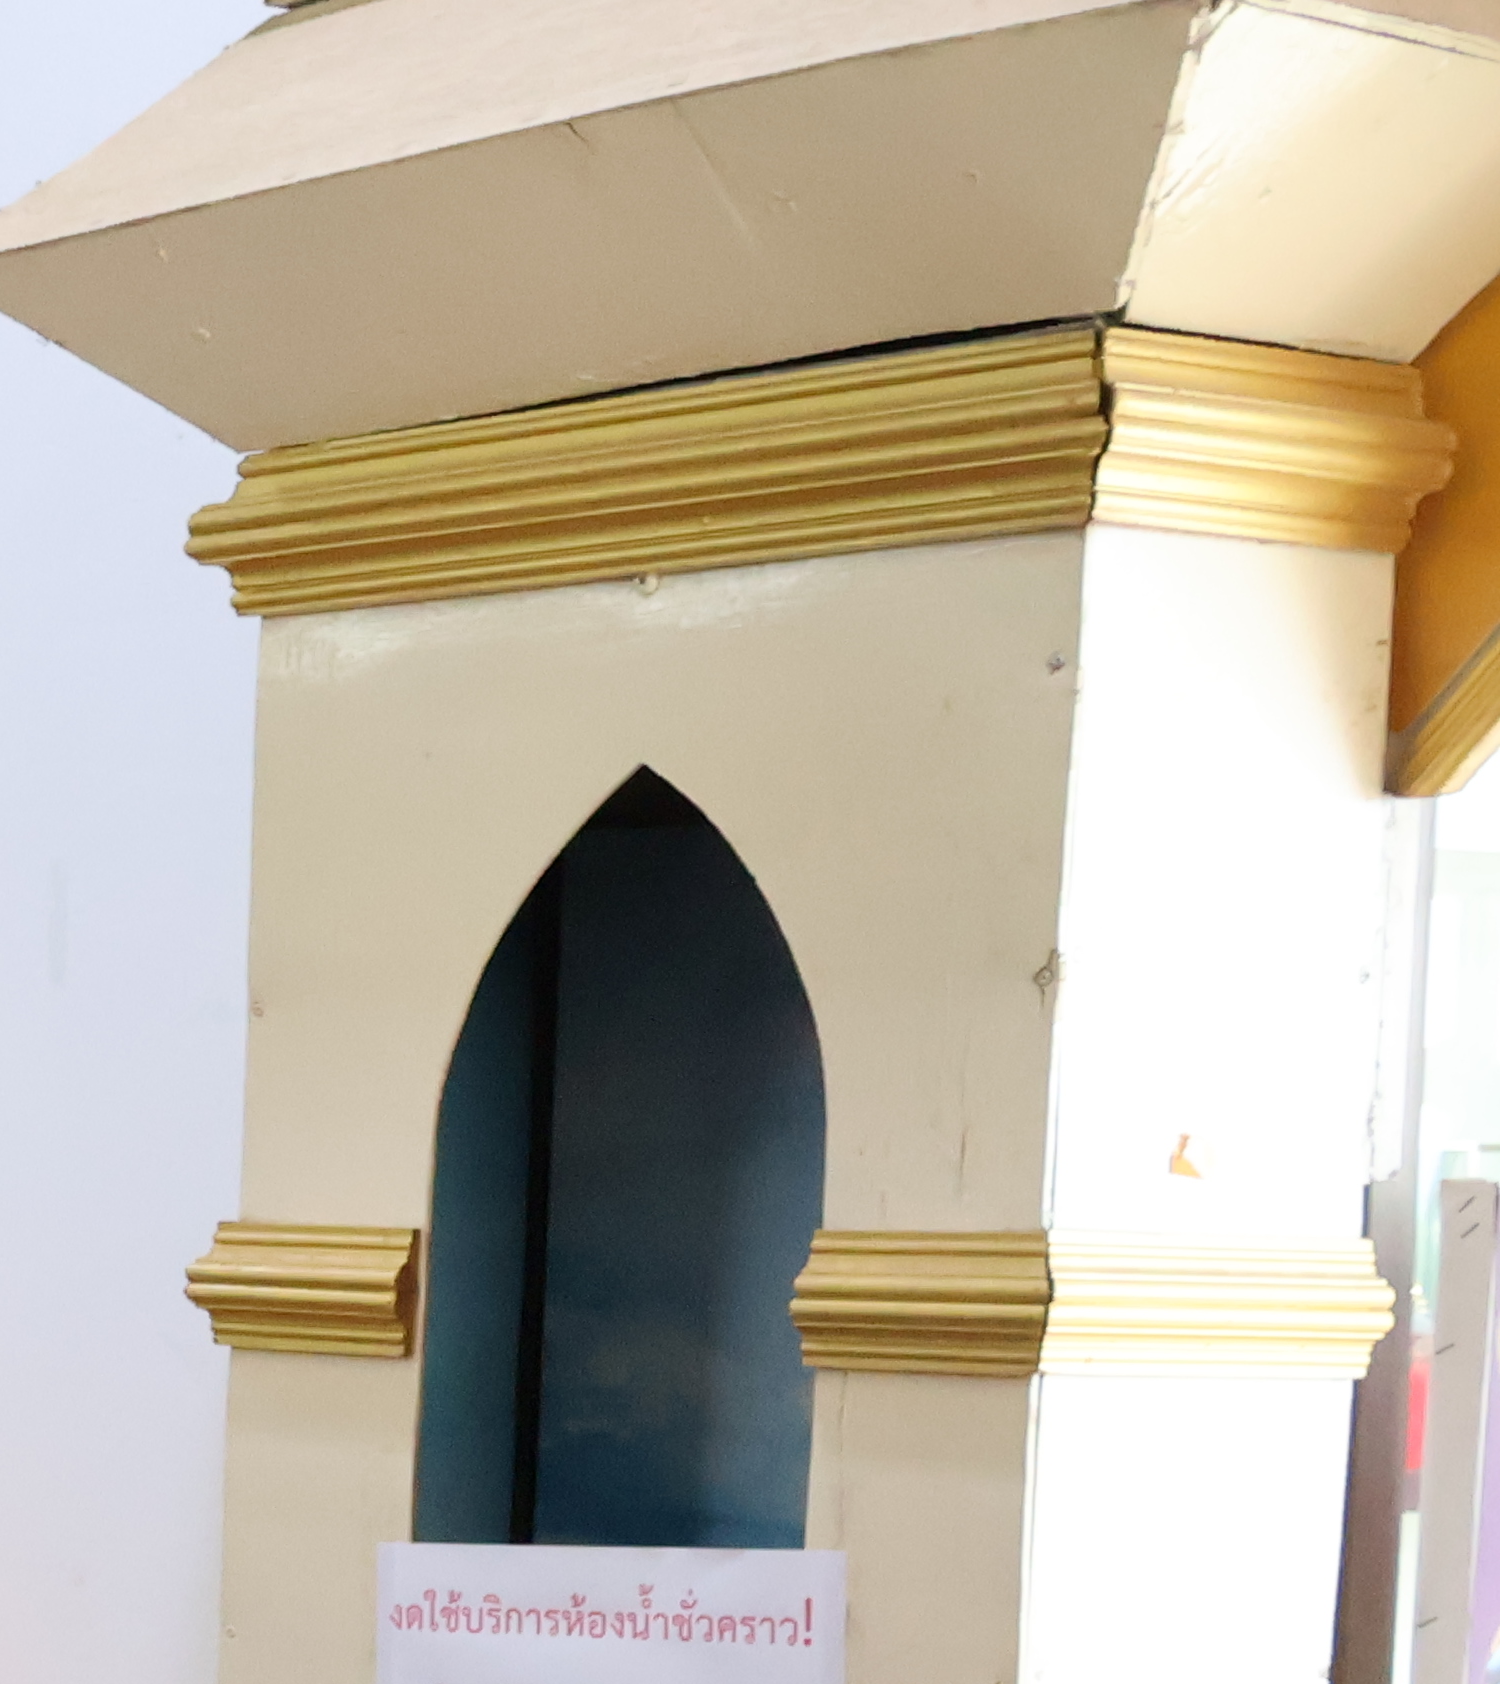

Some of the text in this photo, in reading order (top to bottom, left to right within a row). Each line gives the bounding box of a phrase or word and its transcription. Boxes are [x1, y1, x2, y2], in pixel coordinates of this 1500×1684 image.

[389, 1583, 813, 1648] งดใช้บริการห้องน้ำชั่วคราว!
